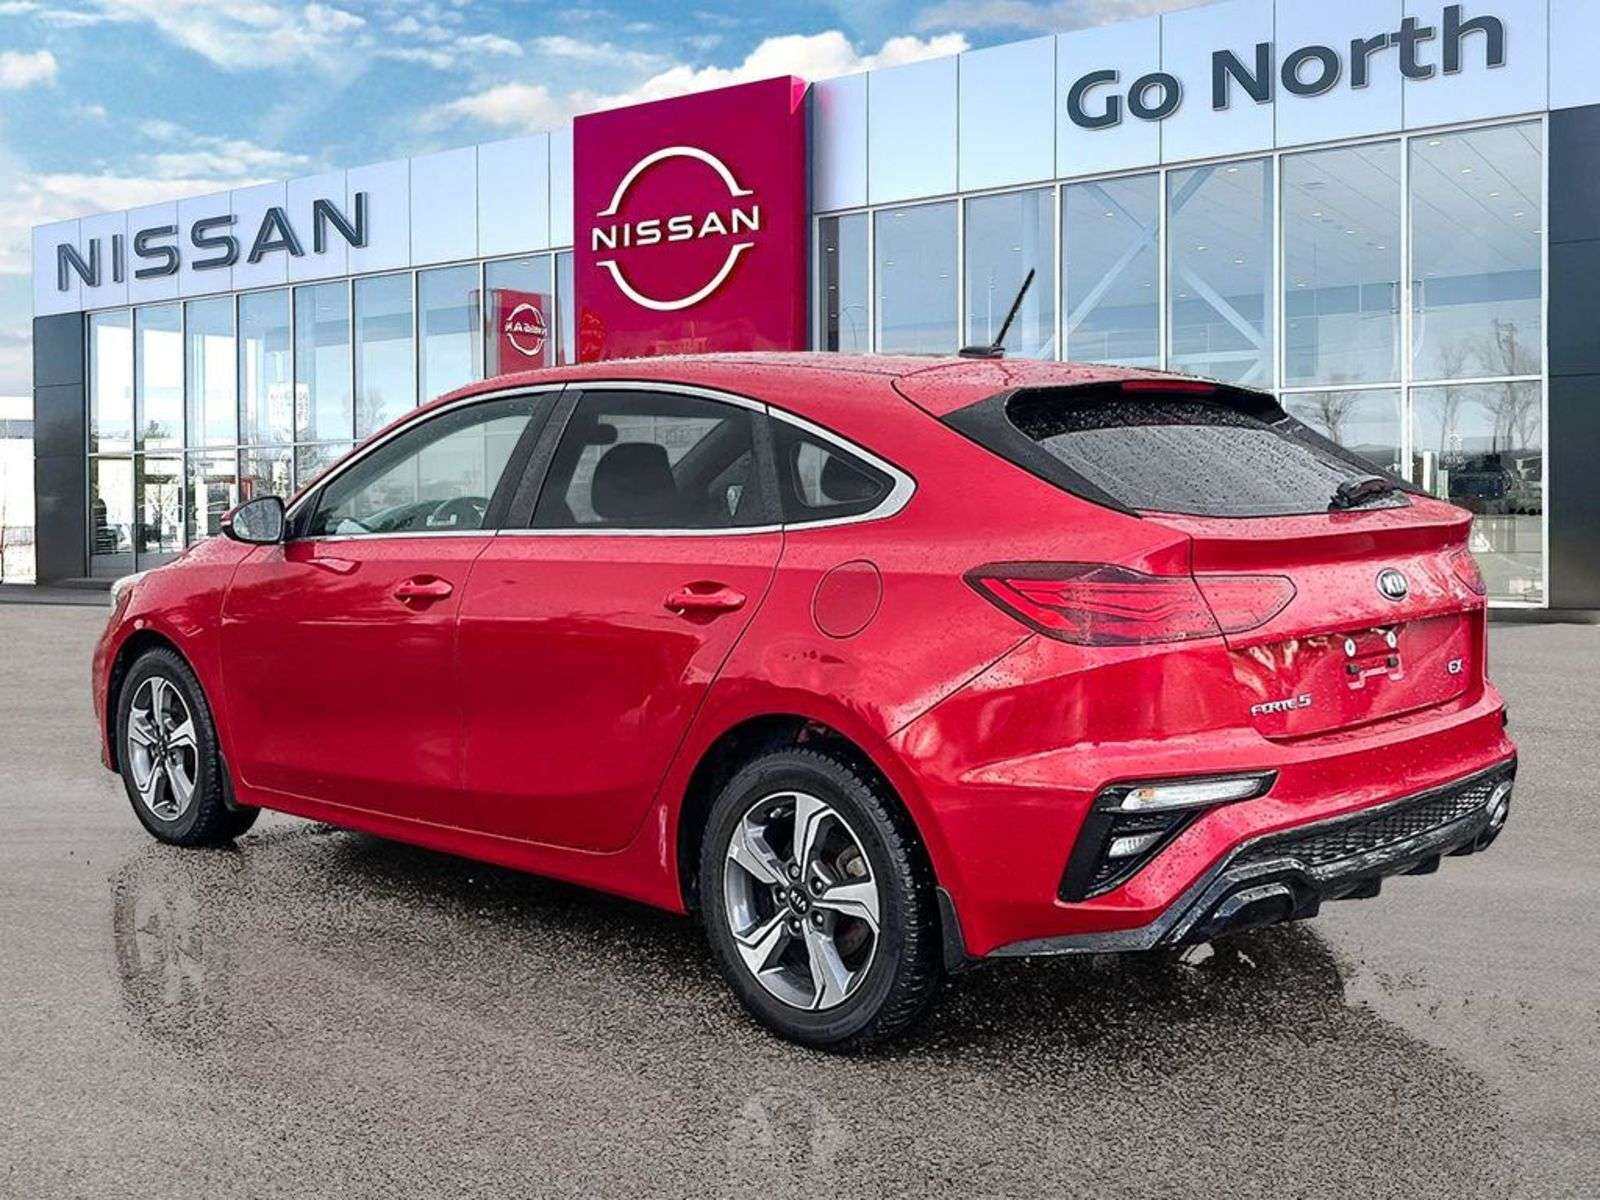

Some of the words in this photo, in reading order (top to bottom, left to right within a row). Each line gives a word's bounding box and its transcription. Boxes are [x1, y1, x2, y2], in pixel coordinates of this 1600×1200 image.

[1066, 69, 1183, 129] Go
[1211, 4, 1506, 111] North
[57, 192, 368, 292] NISSAN
[592, 205, 759, 251] NISSAN
[790, 889, 806, 911] KIA
